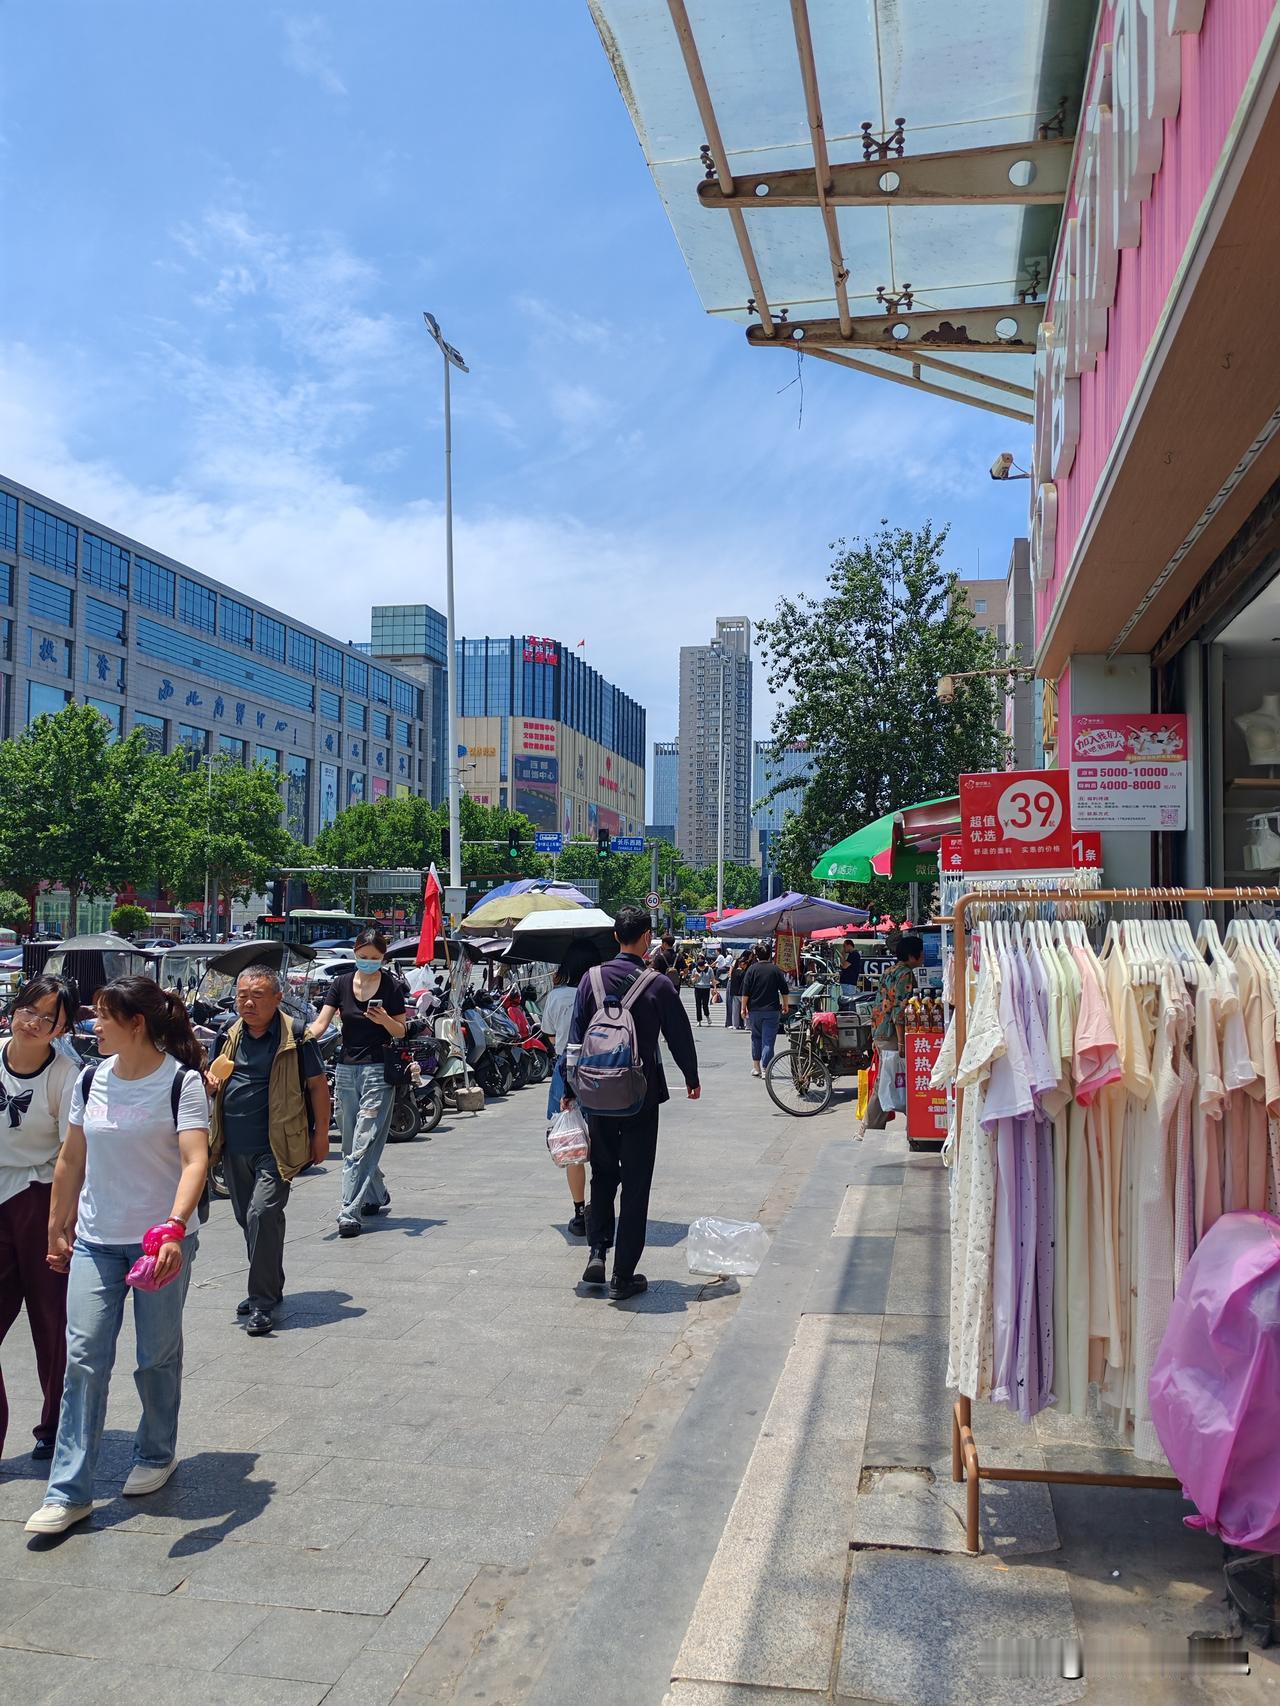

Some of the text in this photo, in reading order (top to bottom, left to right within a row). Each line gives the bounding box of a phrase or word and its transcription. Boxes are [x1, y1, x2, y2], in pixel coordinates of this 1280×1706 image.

[1100, 768, 1168, 777] 5000-10000
[1100, 781, 1161, 790] 4000-8000
[970, 815, 995, 828] 超值
[970, 830, 997, 842] 优选
[950, 839, 1097, 865] 会 1条
[1021, 845, 1060, 854] 实惠的价格
